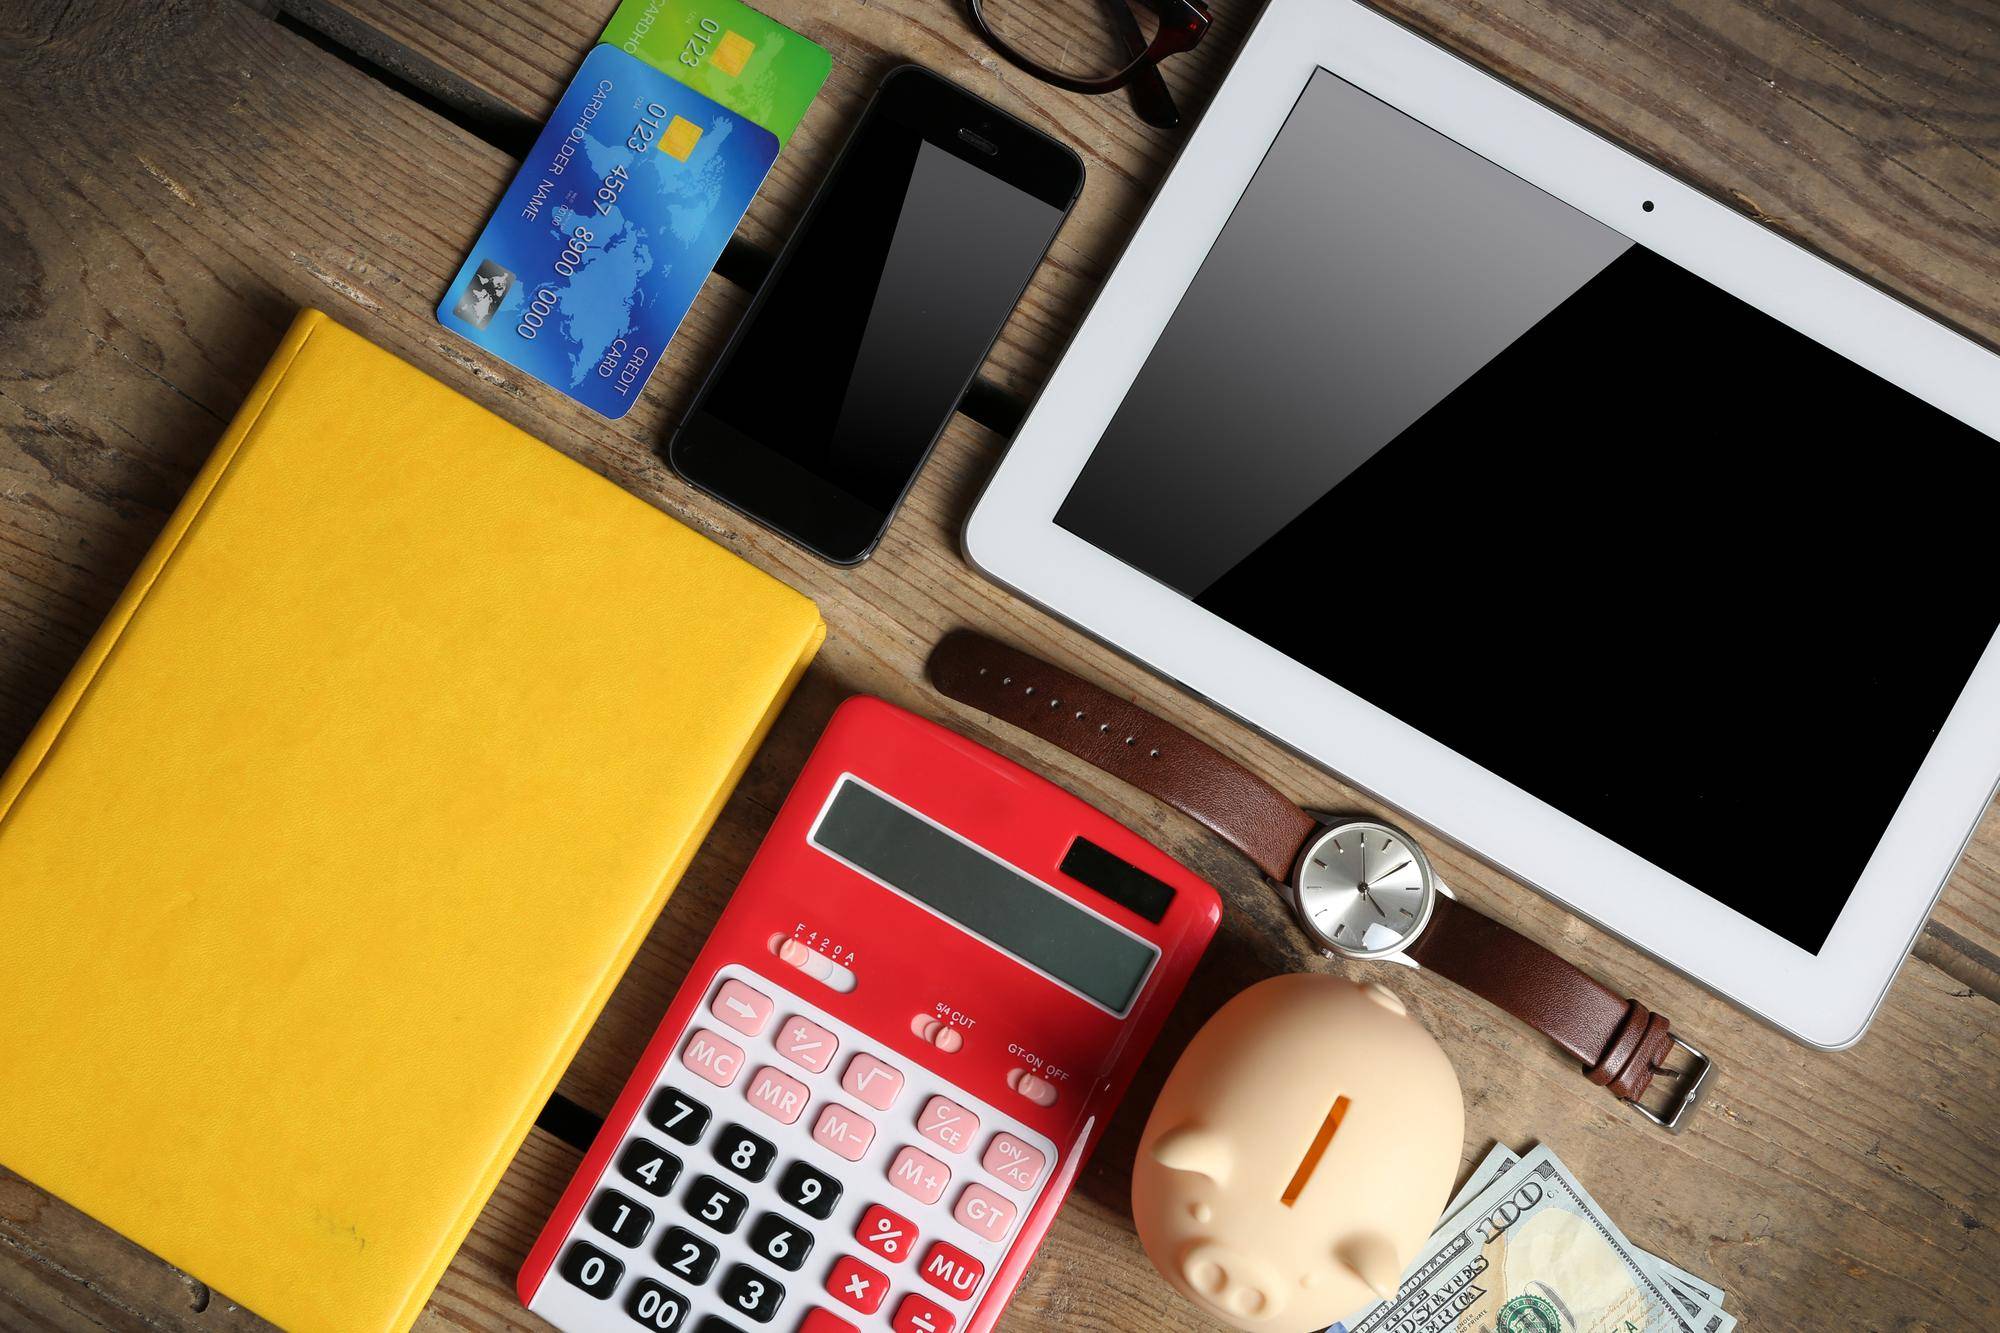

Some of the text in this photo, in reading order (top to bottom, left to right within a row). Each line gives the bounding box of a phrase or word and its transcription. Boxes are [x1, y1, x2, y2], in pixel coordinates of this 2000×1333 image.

[680, 18, 719, 67] 0123
[521, 80, 613, 221] CARDHOLDER NAME
[517, 102, 667, 340] 0123 4567 8900 0000
[599, 339, 627, 378] CARD
[614, 346, 649, 397] CREDIT
[935, 1002, 976, 1029] 5/4 CUT
[689, 1040, 734, 1076] MC
[1008, 1043, 1070, 1082] GT-ON OFF
[664, 1100, 694, 1128] 7
[755, 1080, 798, 1114] MR
[636, 1157, 664, 1185] 4
[731, 1140, 757, 1170] 8
[897, 1158, 938, 1189] M+
[701, 1192, 730, 1221] 5
[798, 1178, 822, 1205] 9
[612, 1204, 631, 1233] 1
[966, 1198, 1004, 1228] GT
[1476, 1182, 1543, 1244] 100
[672, 1243, 700, 1275] 2
[768, 1231, 792, 1259] 6
[580, 1257, 605, 1286] 0
[928, 1254, 975, 1290] MU
[1398, 1238, 1466, 1298] DOLLARS
[739, 1280, 765, 1309] 3
[1412, 1254, 1489, 1325] STATES
[638, 1290, 679, 1329] 00
[1383, 1289, 1430, 1331] THE
[1421, 1285, 1487, 1333] ERICA
